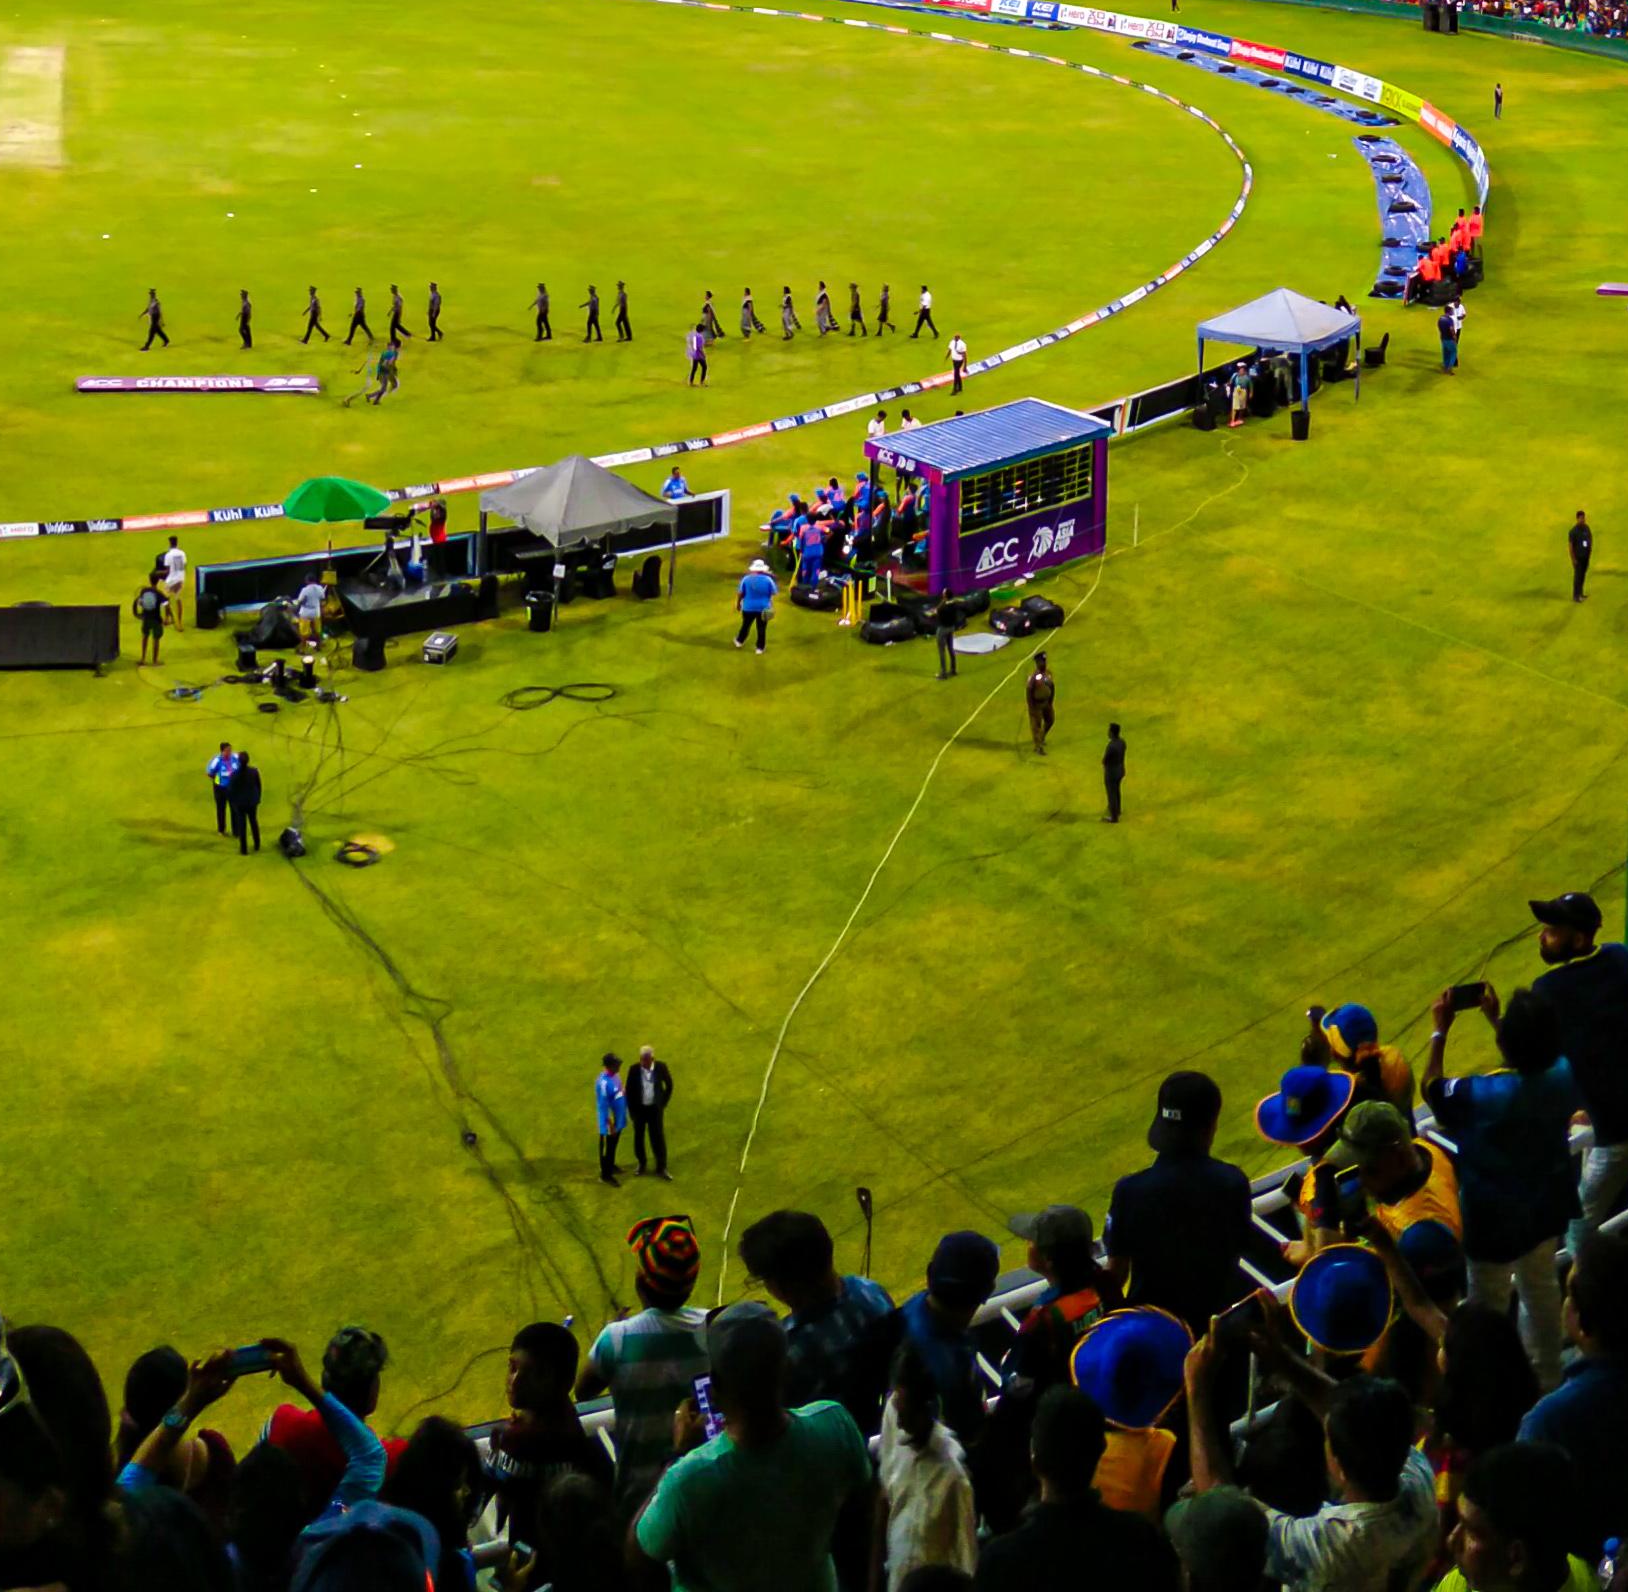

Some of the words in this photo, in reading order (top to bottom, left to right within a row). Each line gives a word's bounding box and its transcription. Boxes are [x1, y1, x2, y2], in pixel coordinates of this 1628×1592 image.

[1032, 1, 1055, 12] KEI
[136, 378, 254, 388] CHAMPIONS
[976, 537, 1020, 573] ACC
